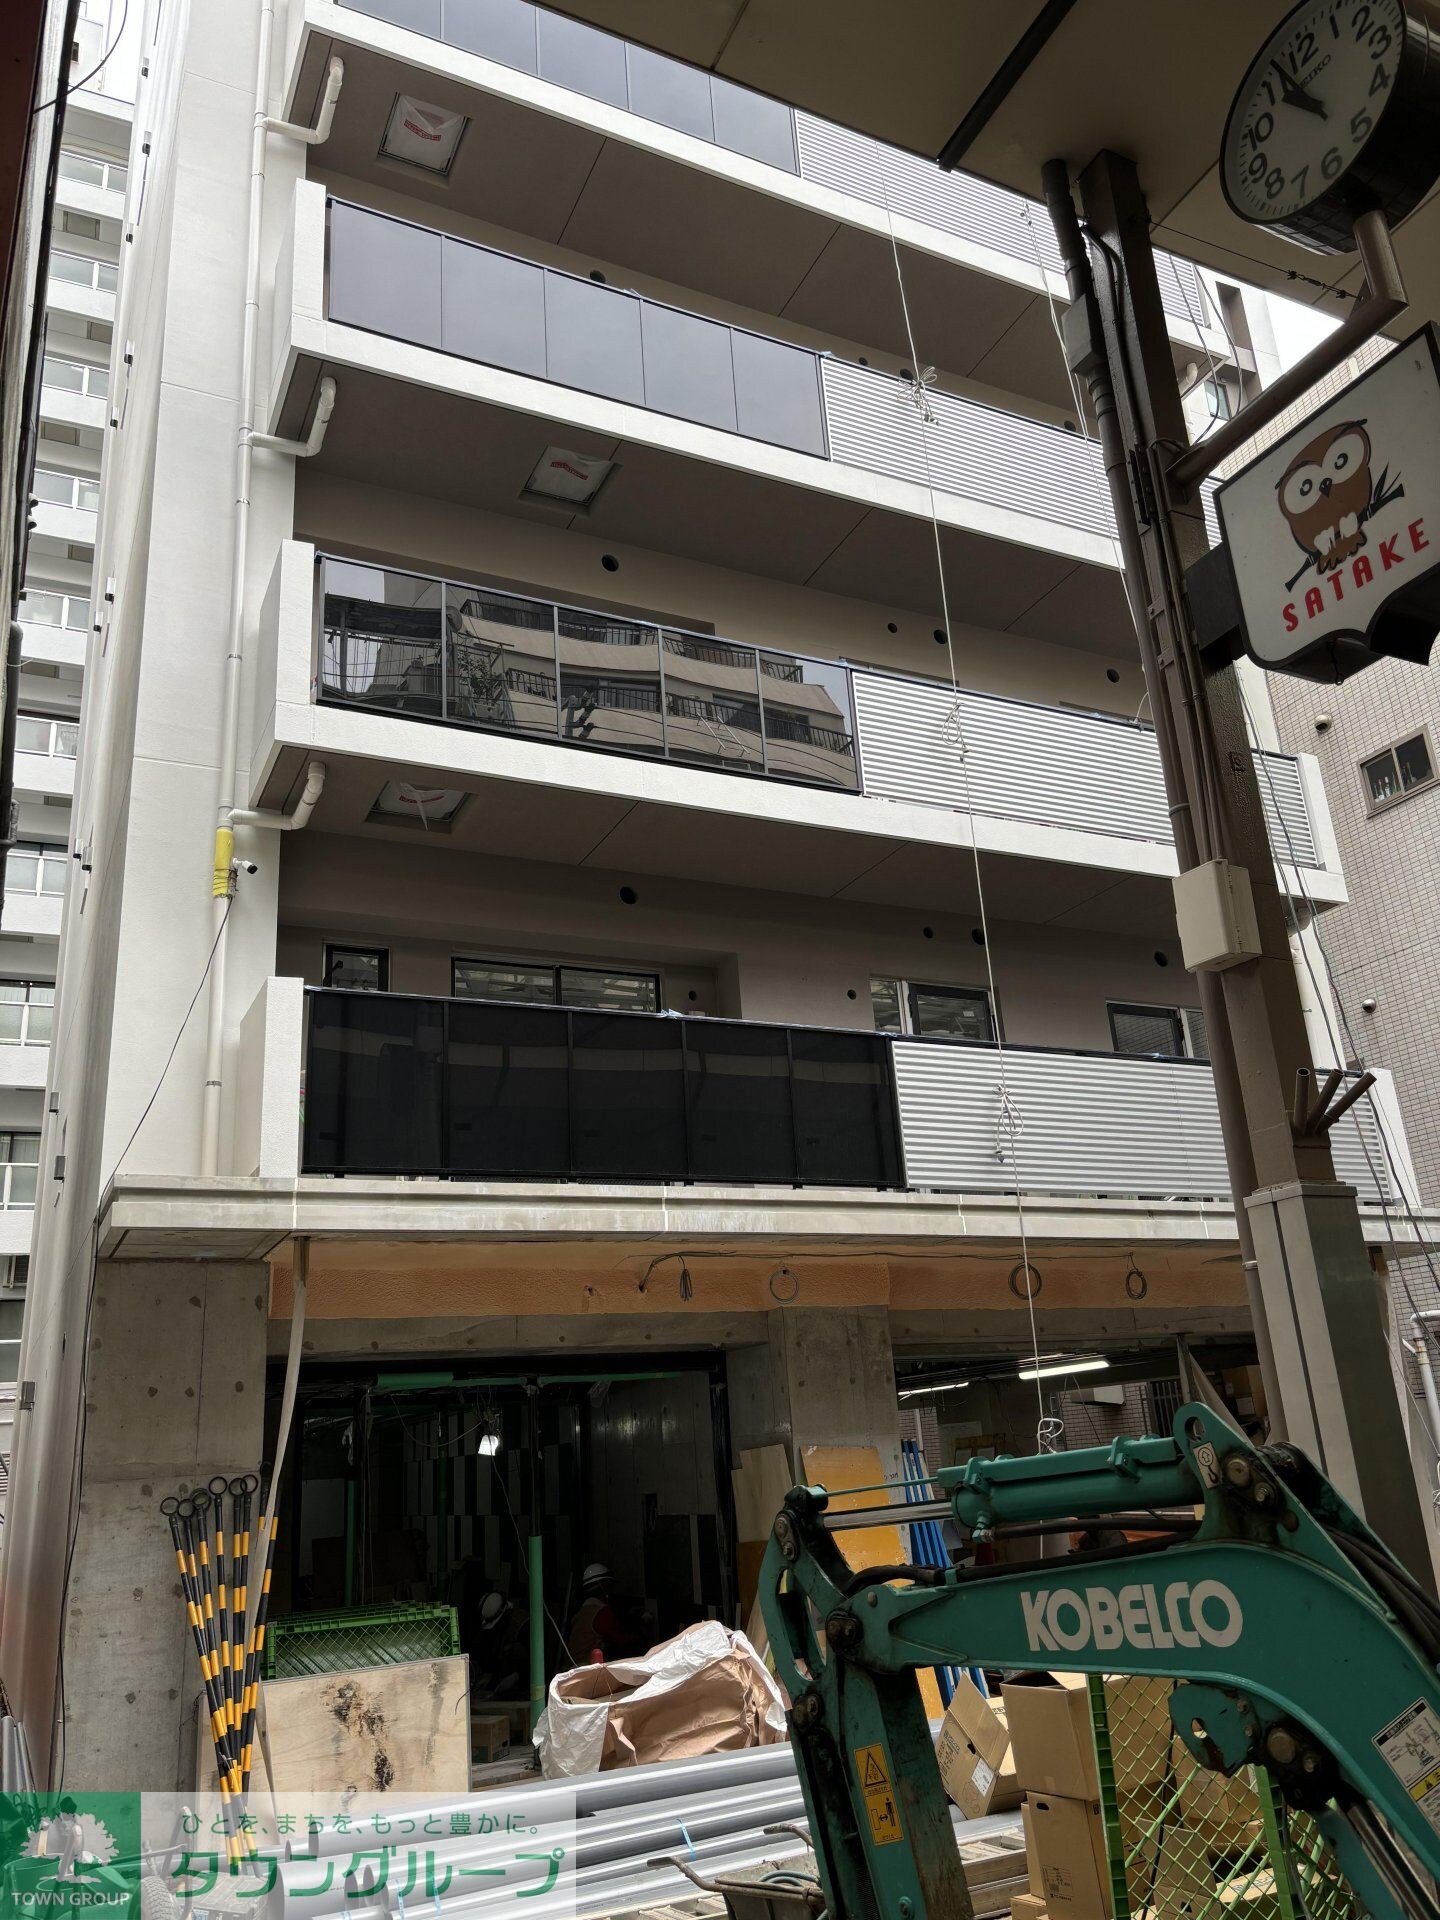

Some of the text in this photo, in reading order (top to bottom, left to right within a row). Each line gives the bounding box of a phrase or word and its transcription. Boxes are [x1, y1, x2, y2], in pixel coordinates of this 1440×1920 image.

[1329, 14, 1340, 40] 1
[1352, 5, 1375, 42] 2
[1288, 32, 1319, 75] 12
[1368, 24, 1392, 60] 3
[1369, 62, 1392, 98] 4
[1249, 112, 1274, 151] 10
[1350, 107, 1373, 144] 5
[1249, 153, 1268, 184] 9
[1290, 164, 1310, 198] 7
[1321, 147, 1343, 181] 6
[1265, 167, 1285, 199] 8
[1282, 517, 1430, 633] SATAKE
[1020, 1579, 1243, 1652] KOBELCO
